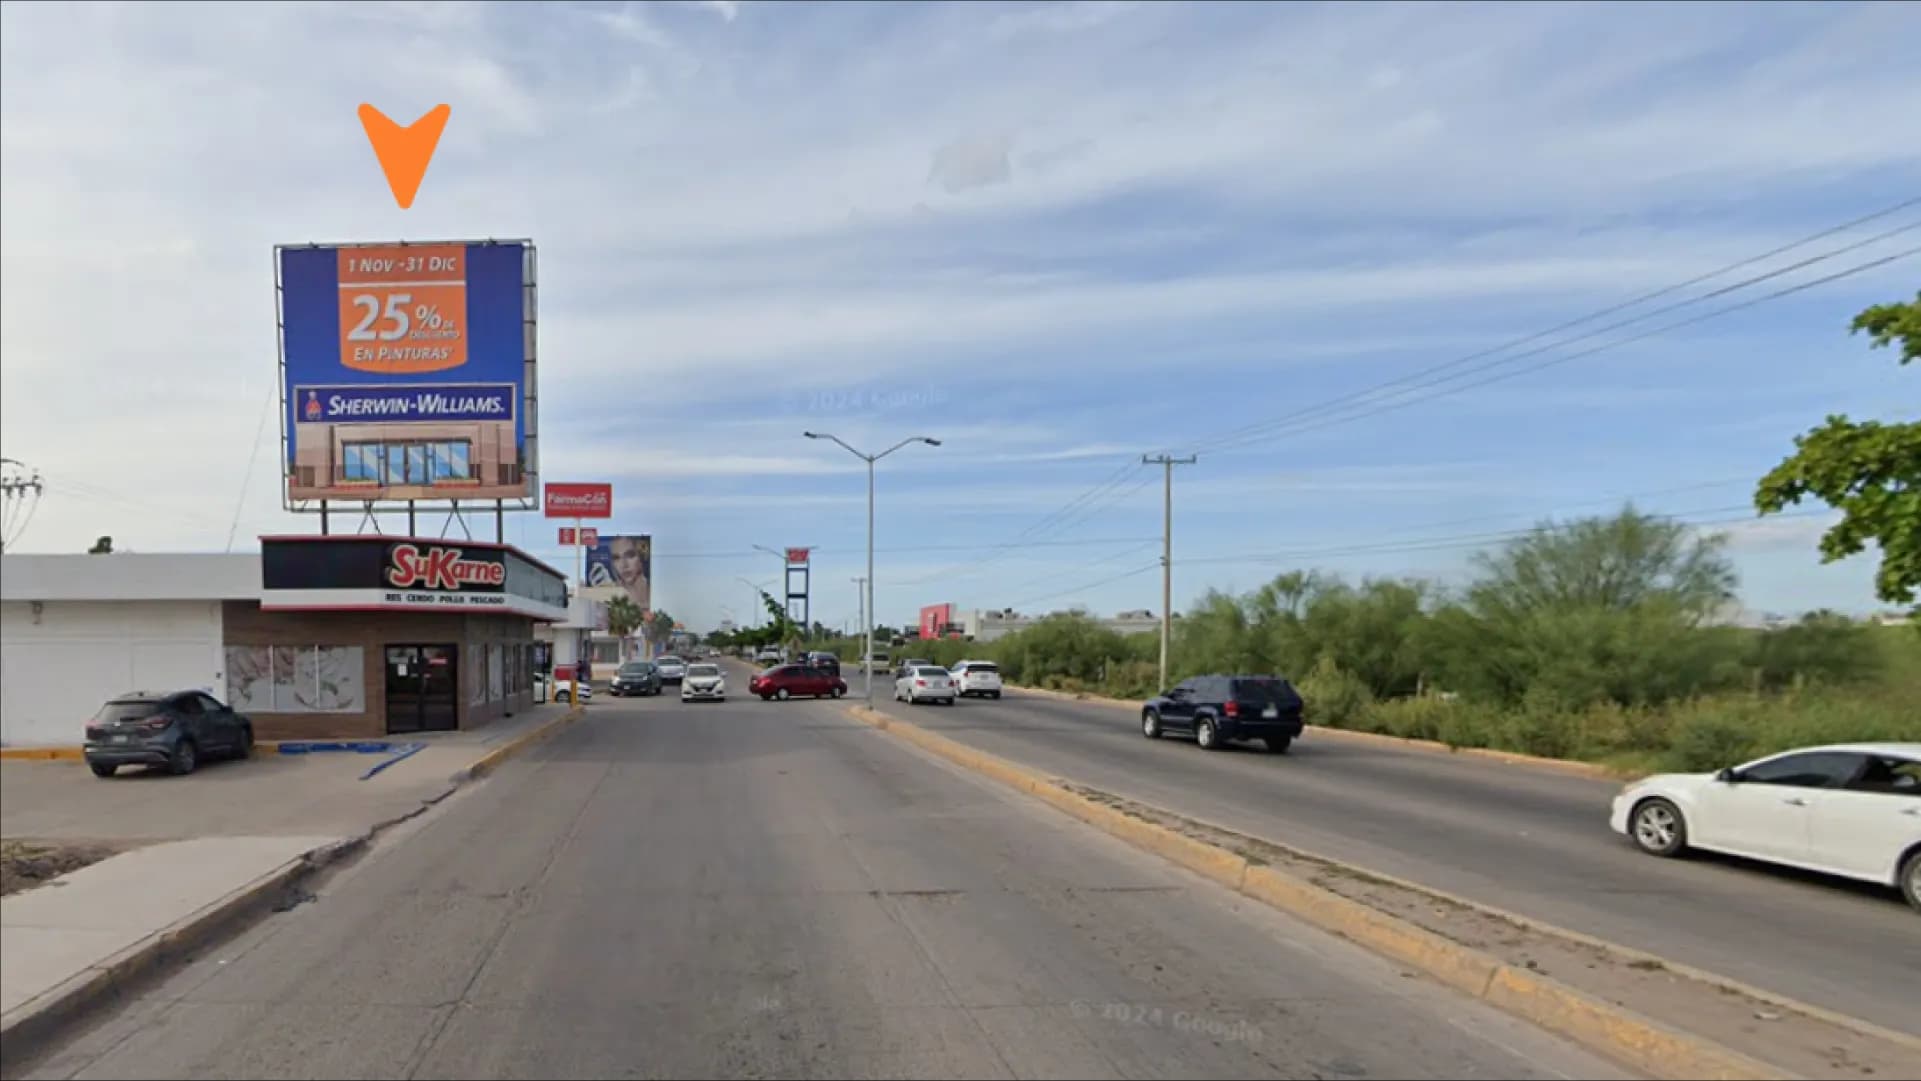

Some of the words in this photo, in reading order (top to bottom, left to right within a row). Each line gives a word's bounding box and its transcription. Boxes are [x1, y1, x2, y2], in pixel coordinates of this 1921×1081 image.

[349, 259, 356, 273] 1
[359, 258, 394, 272] NOV
[429, 256, 457, 271] DIC
[354, 347, 374, 361] EN
[390, 544, 505, 589] SuKarne
